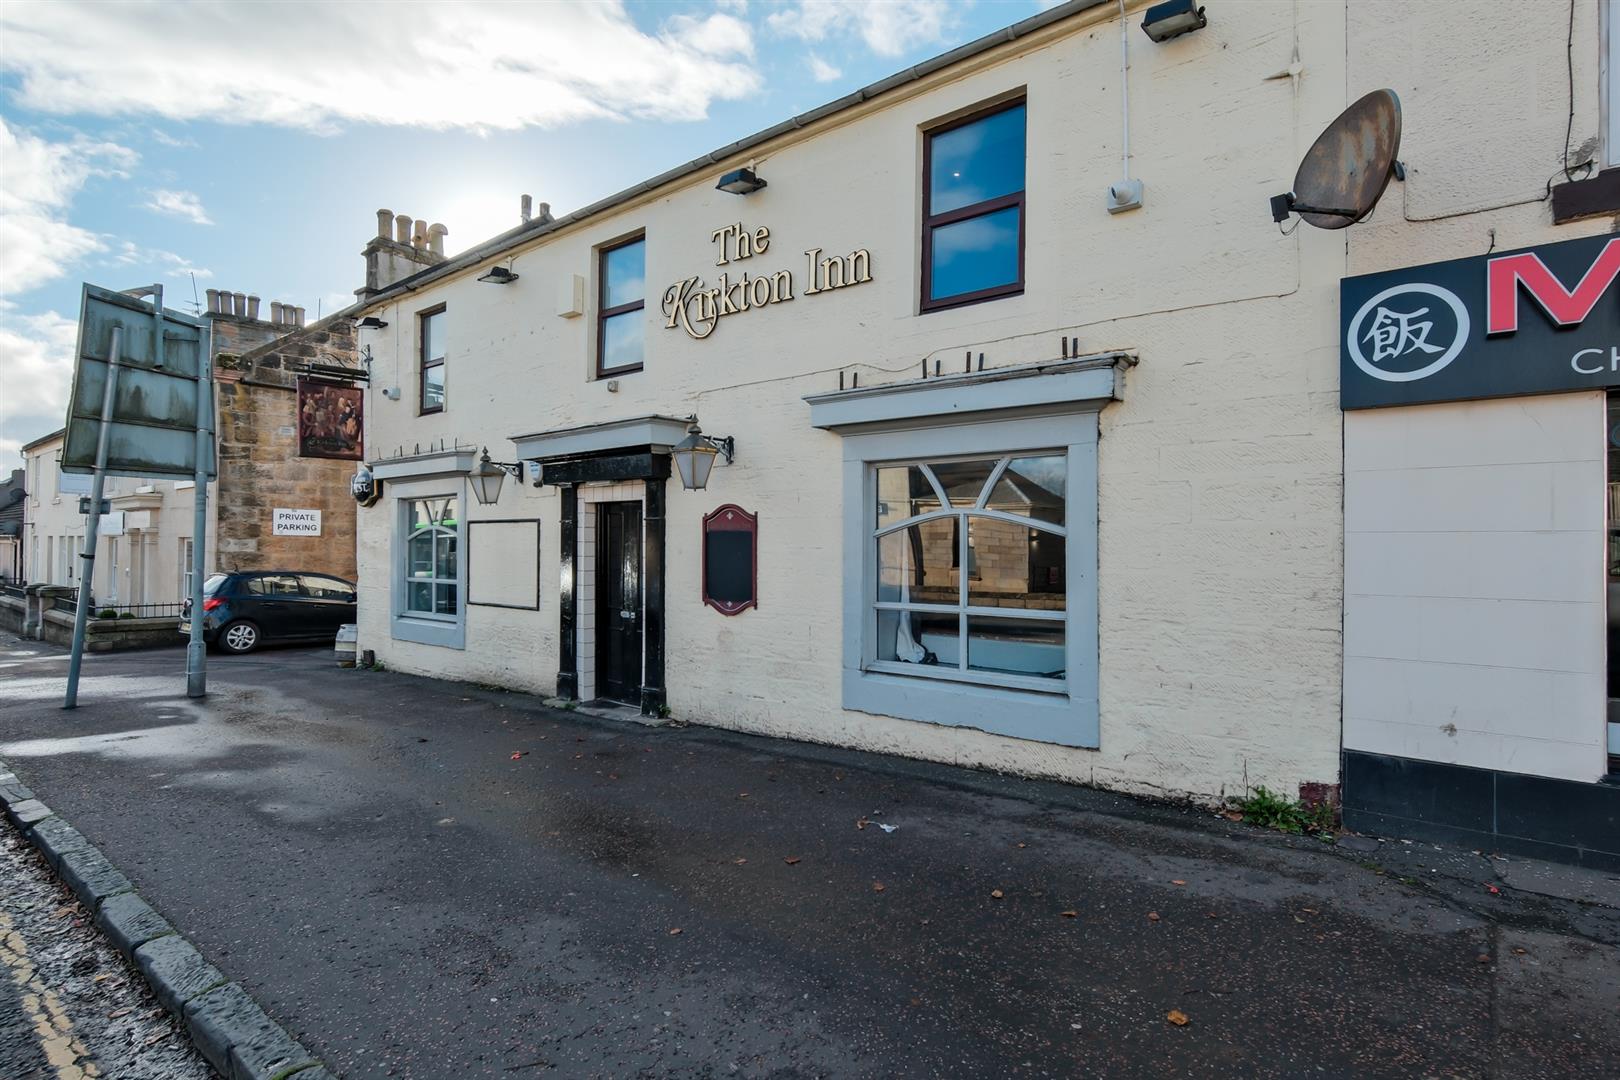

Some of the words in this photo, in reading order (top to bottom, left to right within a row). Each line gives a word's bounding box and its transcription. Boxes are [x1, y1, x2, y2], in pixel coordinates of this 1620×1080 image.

[711, 221, 770, 266] The
[661, 269, 794, 339] Kirkton
[804, 247, 873, 296] Inn
[1361, 306, 1447, 362] 飯
[277, 523, 317, 531] PARKING
[279, 513, 316, 521] PRIVATE
